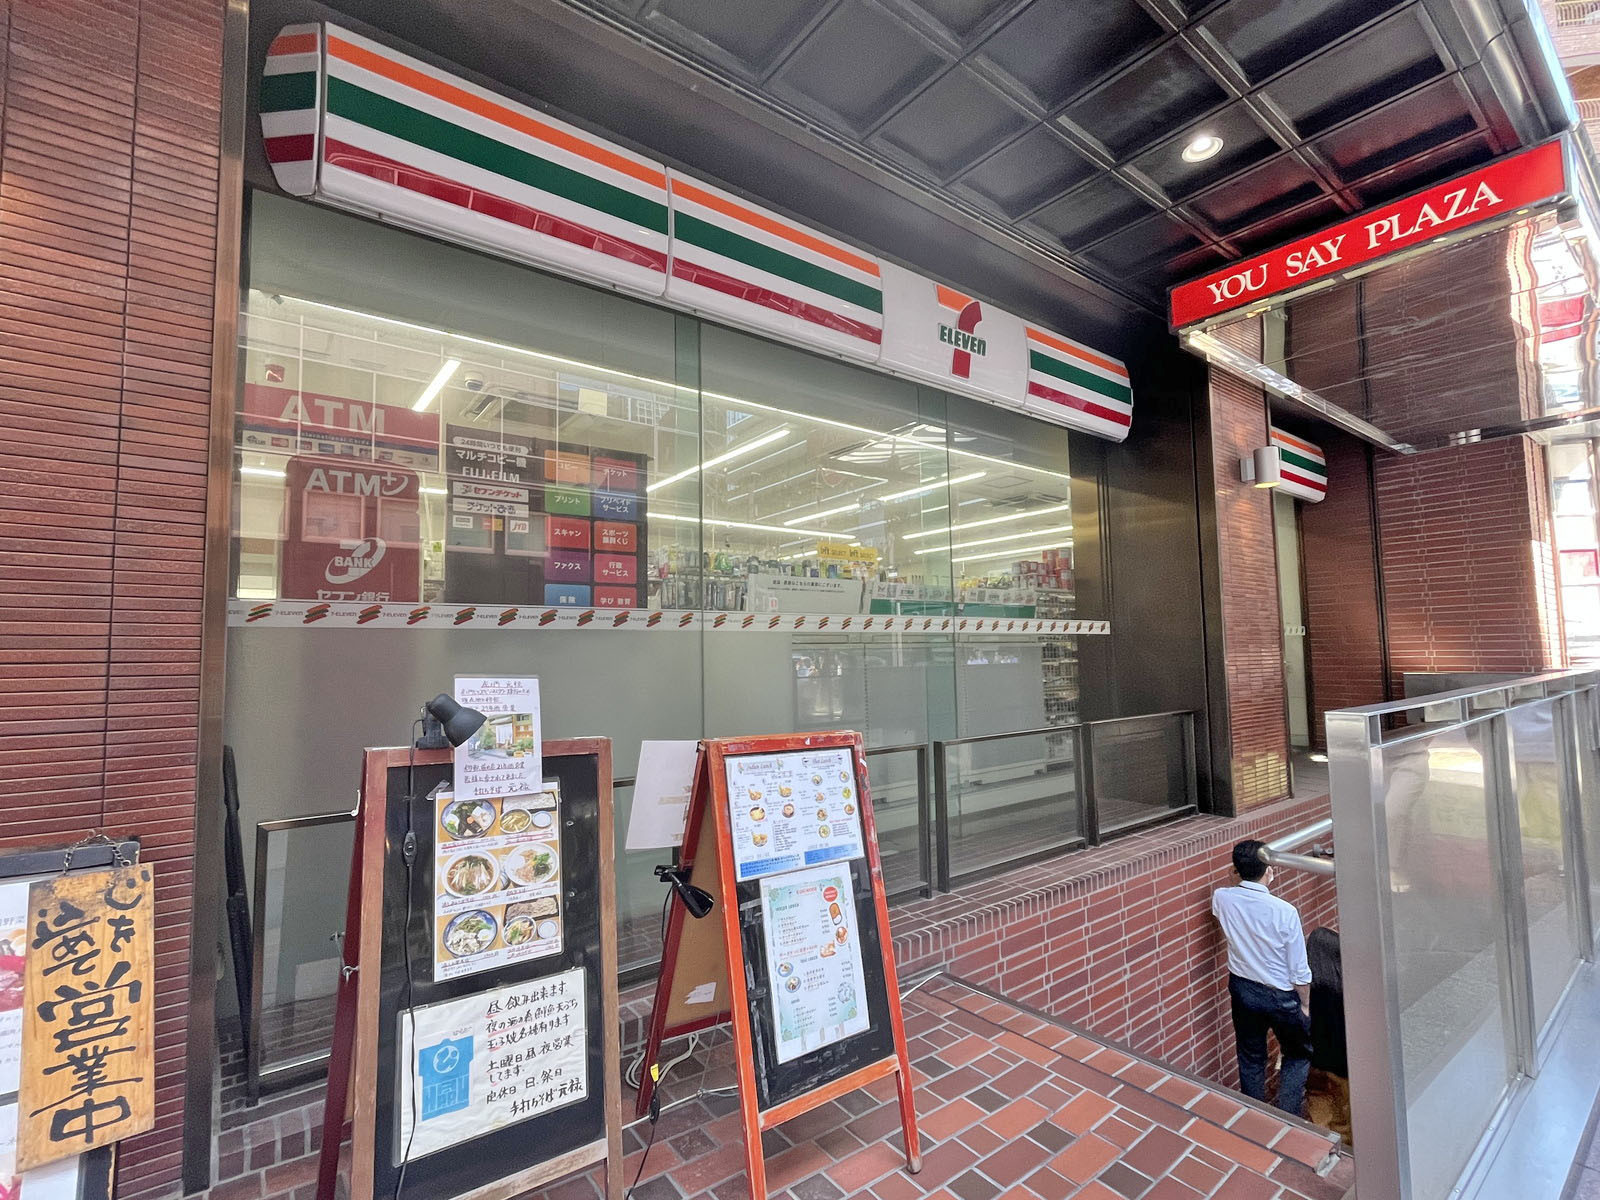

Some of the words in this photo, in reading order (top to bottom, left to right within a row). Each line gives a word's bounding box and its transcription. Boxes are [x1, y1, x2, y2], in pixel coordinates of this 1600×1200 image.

[1206, 264, 1269, 305] YOU
[1285, 233, 1348, 278] SAY
[1364, 180, 1504, 251] PLAZA
[278, 395, 386, 434] ATM
[554, 495, 581, 505] プリント
[602, 503, 629, 514] サービス
[554, 528, 582, 537] スキャン
[602, 528, 629, 538] スポーツ
[334, 556, 374, 569] BANK
[554, 562, 582, 571] ファクス
[602, 568, 629, 578] サービス
[30, 961, 144, 1144] 営業中
[486, 1085, 517, 1104] 定休日
